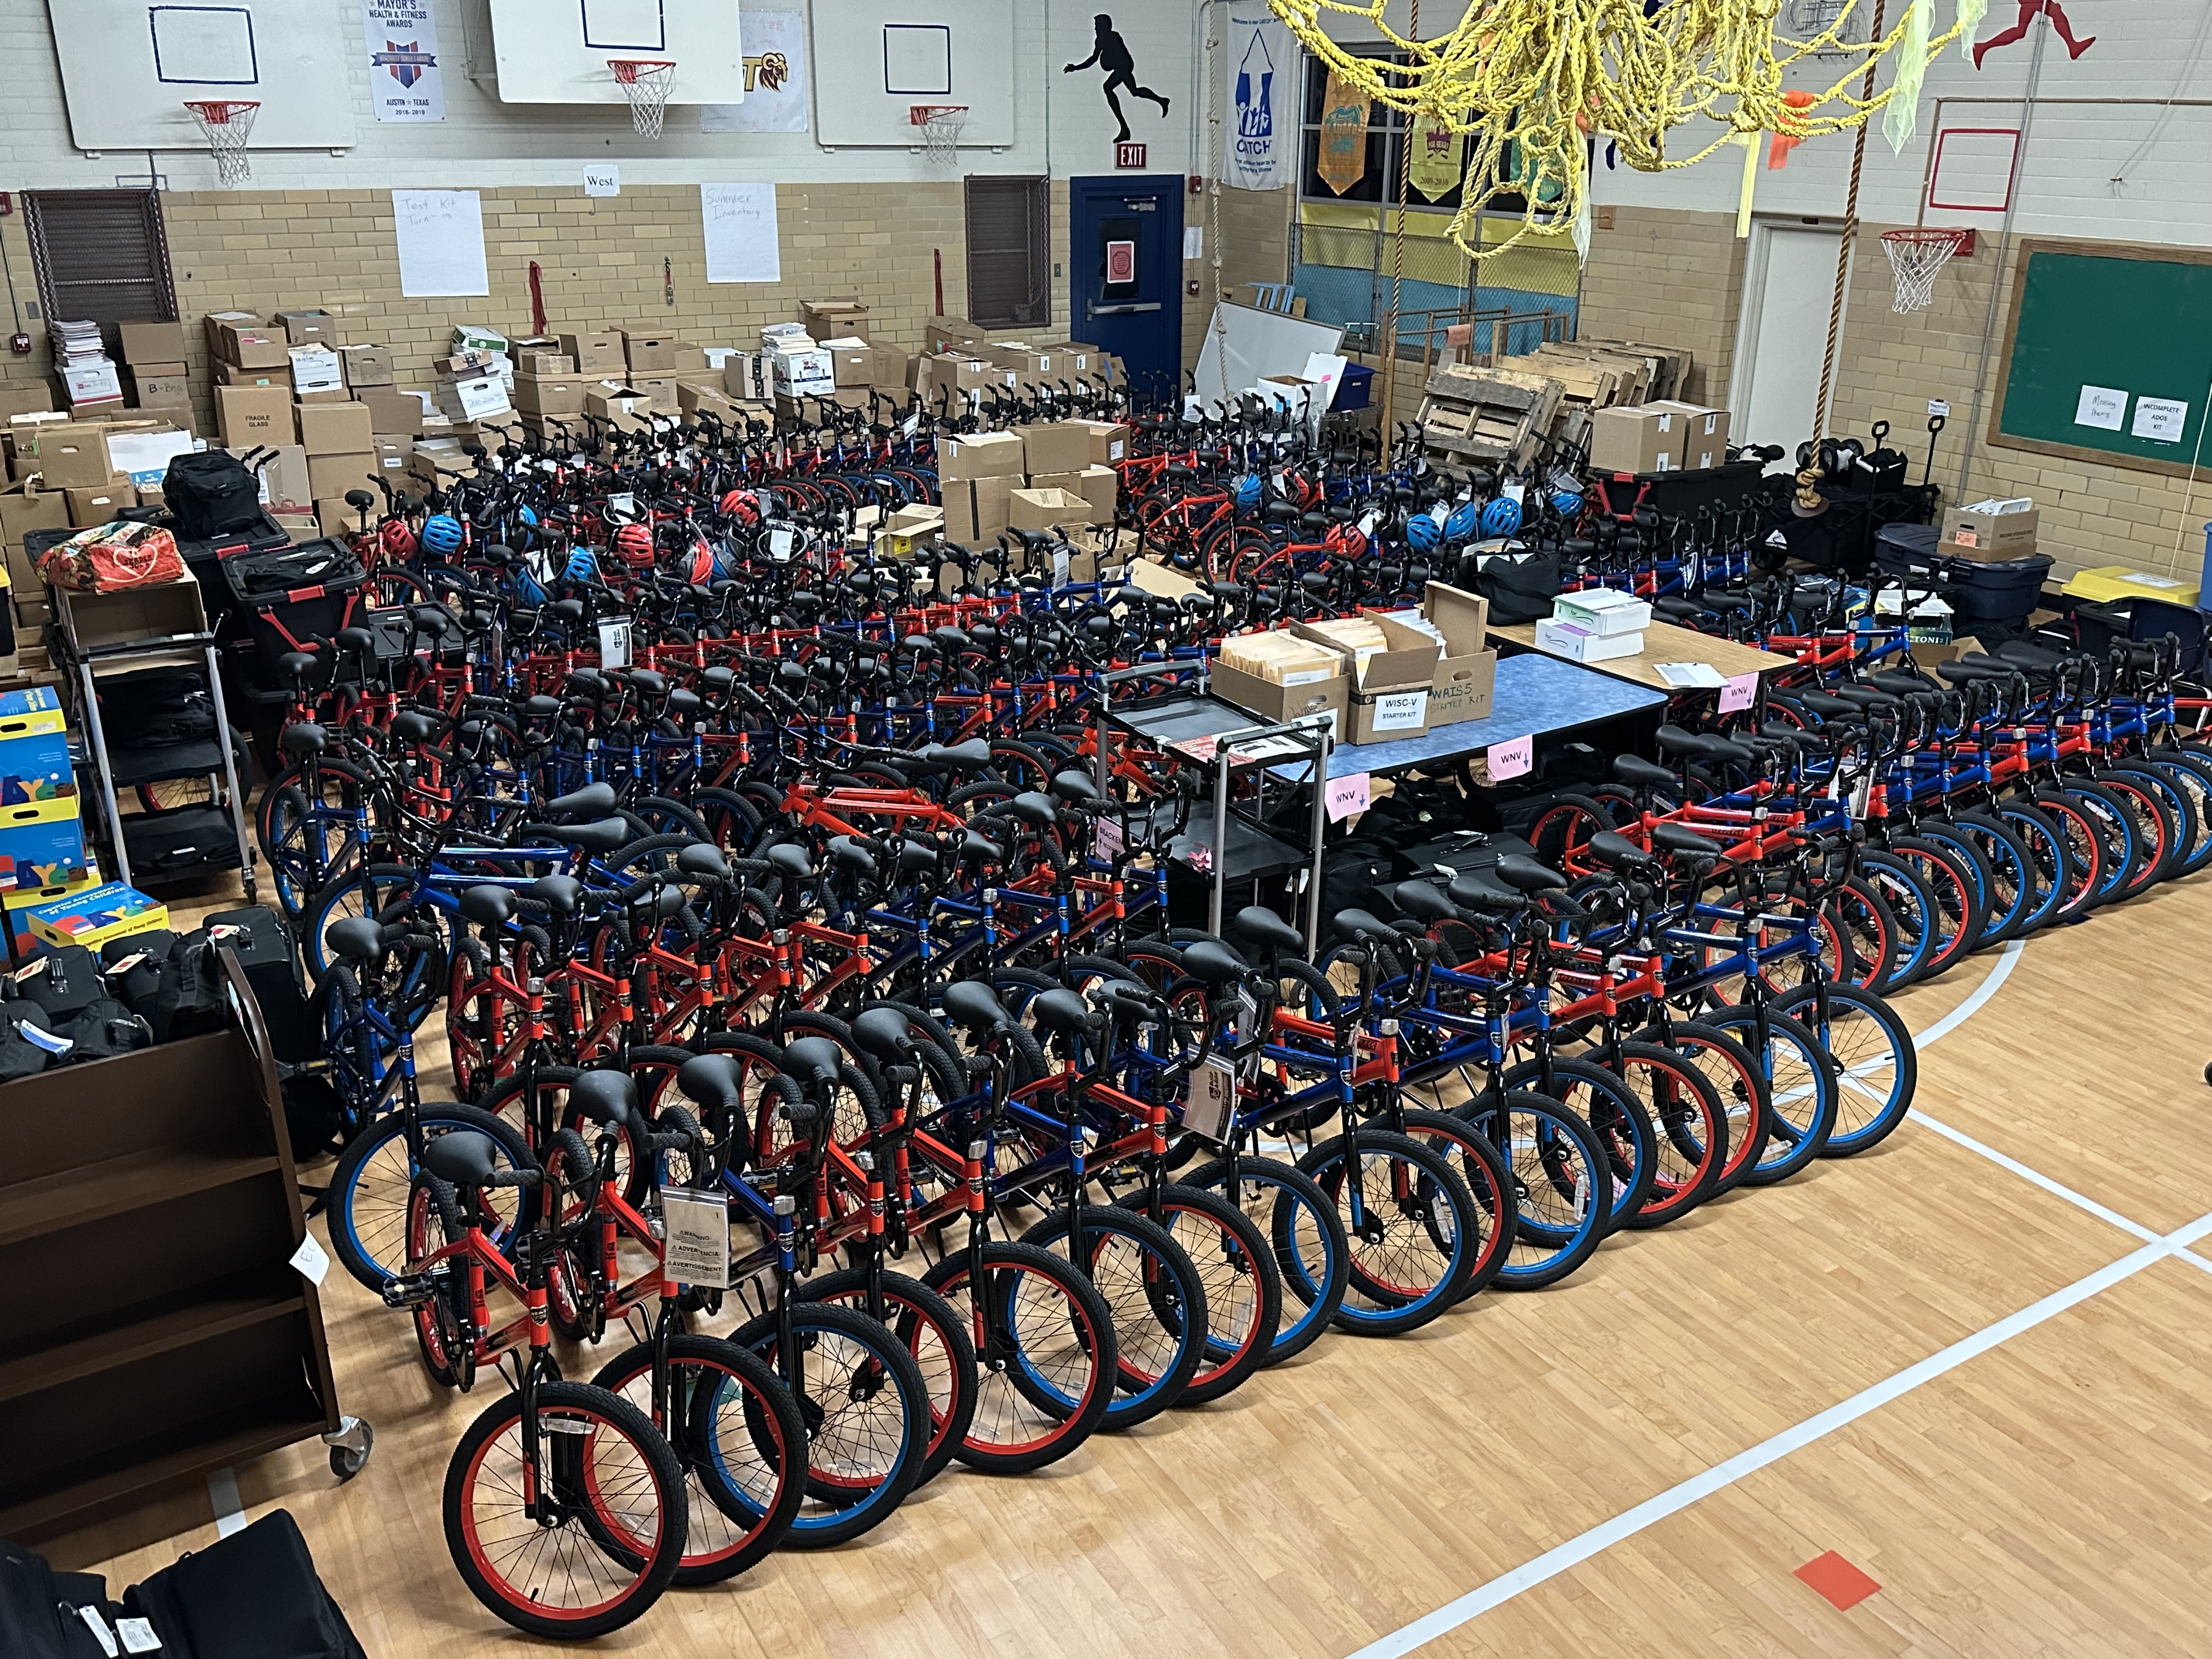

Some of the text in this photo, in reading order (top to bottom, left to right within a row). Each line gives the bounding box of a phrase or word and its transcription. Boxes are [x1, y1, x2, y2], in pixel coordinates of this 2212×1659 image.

[377, 0, 416, 9] MAYOR'S
[369, 9, 427, 19] HEALTH & FITNESS
[386, 19, 413, 28] AWARDS
[1237, 139, 1269, 154] CATCH
[1121, 146, 1143, 166] EXIT
[586, 176, 613, 187] West
[706, 188, 752, 205] Summer
[401, 198, 456, 211] Test Kit
[713, 206, 760, 221] Inventory
[2092, 395, 2116, 409] Missing
[2144, 403, 2180, 414] INCOMPLETE
[1731, 686, 1748, 697] WNV
[1385, 698, 1417, 708] WISC-V
[1469, 694, 1486, 704] KIT
[1500, 751, 1522, 764] WNV
[1336, 790, 1355, 804] WNV
[38, 886, 115, 915] Cognitive Assessment
[59, 899, 88, 912] Young
[89, 887, 126, 901] Children
